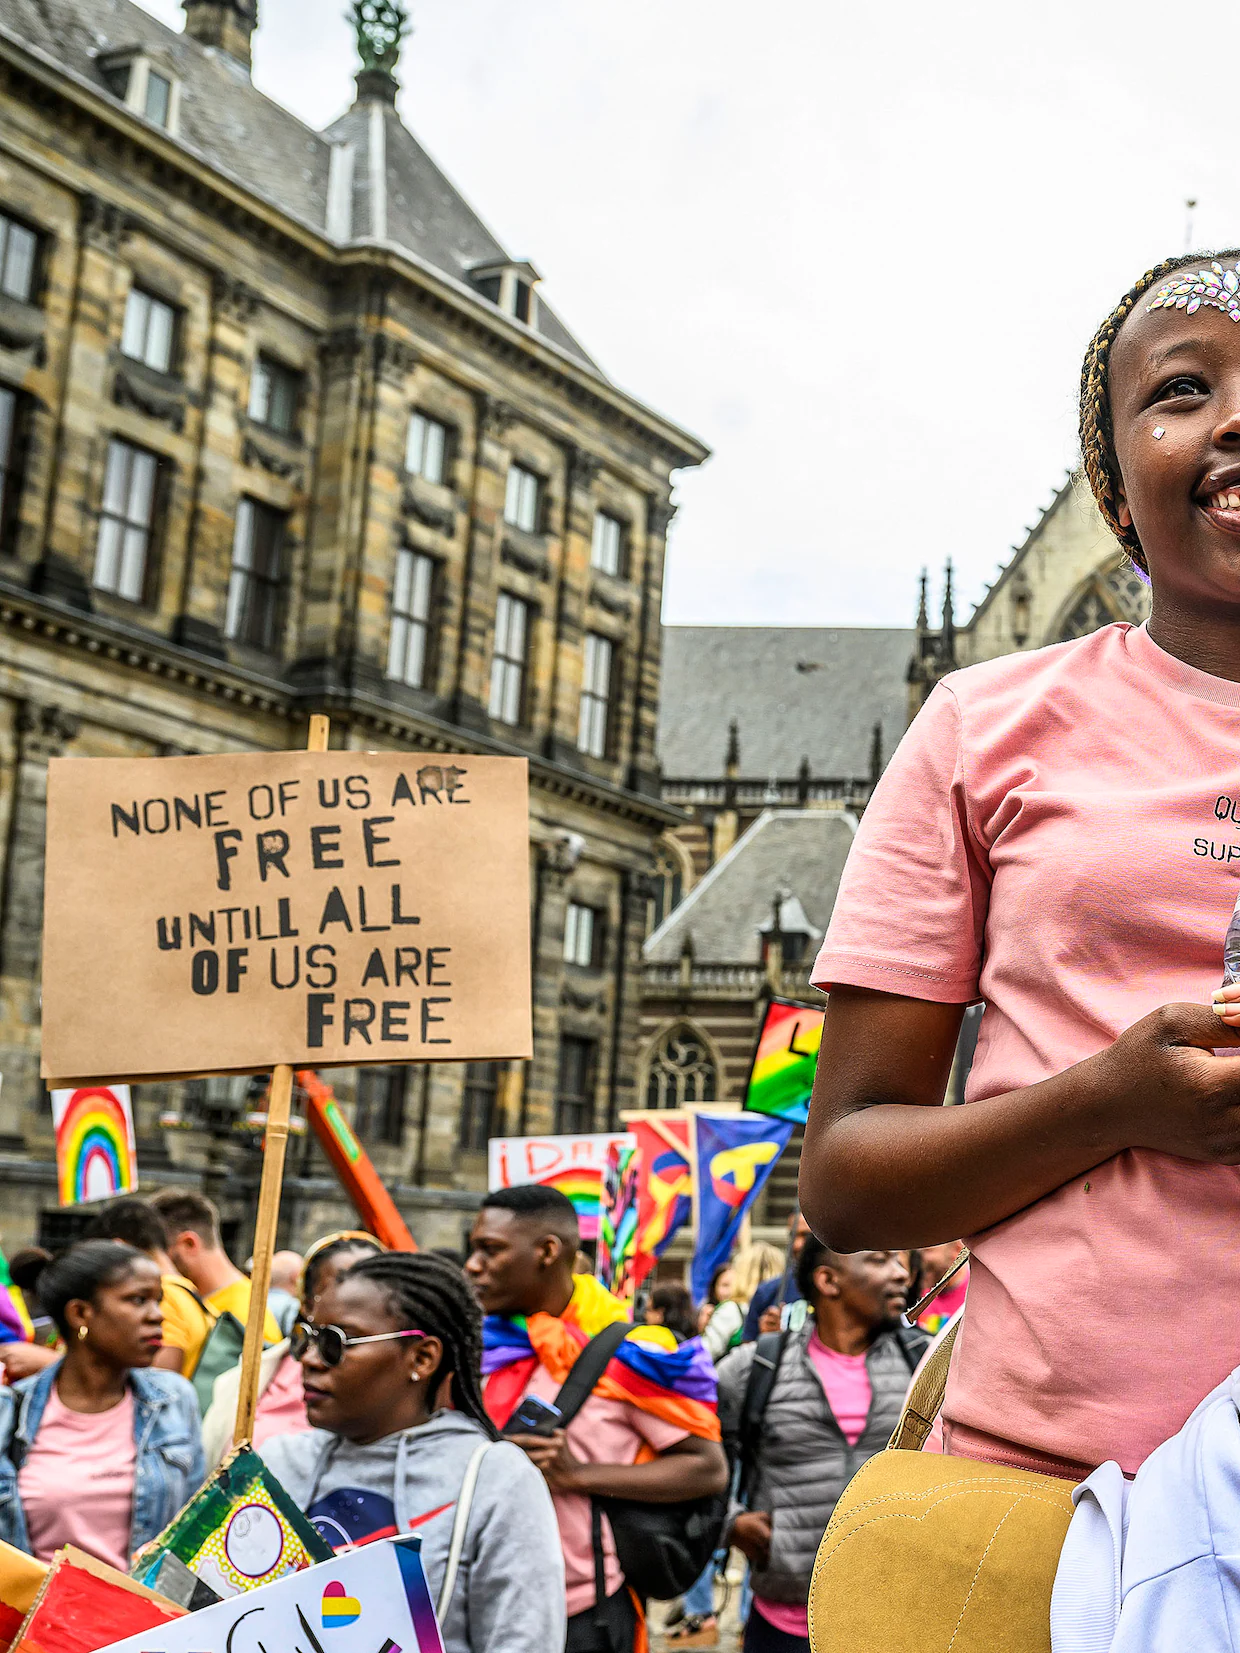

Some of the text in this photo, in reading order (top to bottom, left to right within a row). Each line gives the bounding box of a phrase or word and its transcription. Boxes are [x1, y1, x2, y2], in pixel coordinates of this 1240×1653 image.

[110, 764, 471, 838] NONE OF US ARE
[214, 815, 401, 891] FREE
[318, 883, 421, 934] ALL
[191, 943, 452, 995] OF US ARE
[306, 992, 452, 1048] FREE
